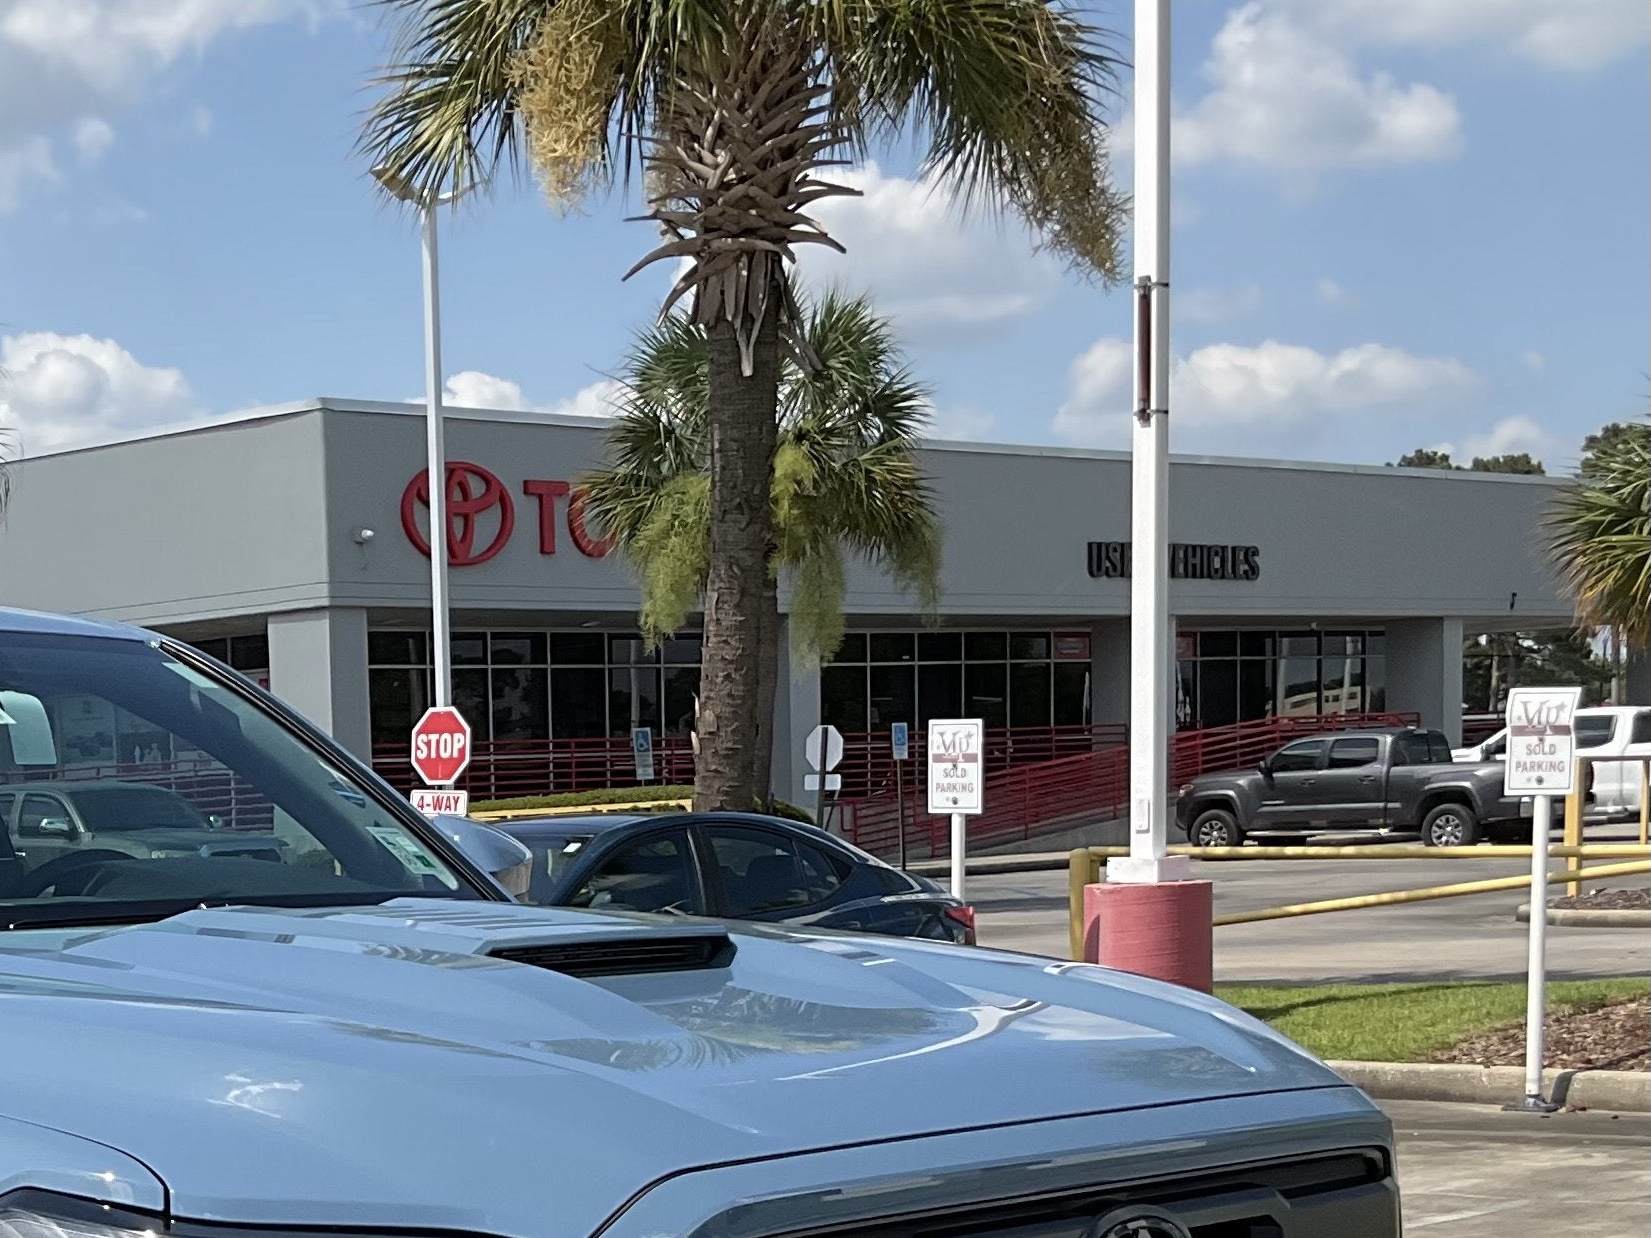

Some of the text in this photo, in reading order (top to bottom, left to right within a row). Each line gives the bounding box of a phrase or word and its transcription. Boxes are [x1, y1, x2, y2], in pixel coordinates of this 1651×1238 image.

[1168, 544, 1260, 581] EHICLES
[416, 732, 465, 759] STOP
[1525, 743, 1556, 756] SOLD
[942, 767, 967, 779] SOLD
[1515, 760, 1566, 773] PARKING
[935, 782, 974, 793] PARKING
[417, 795, 460, 812] 4-WAY
